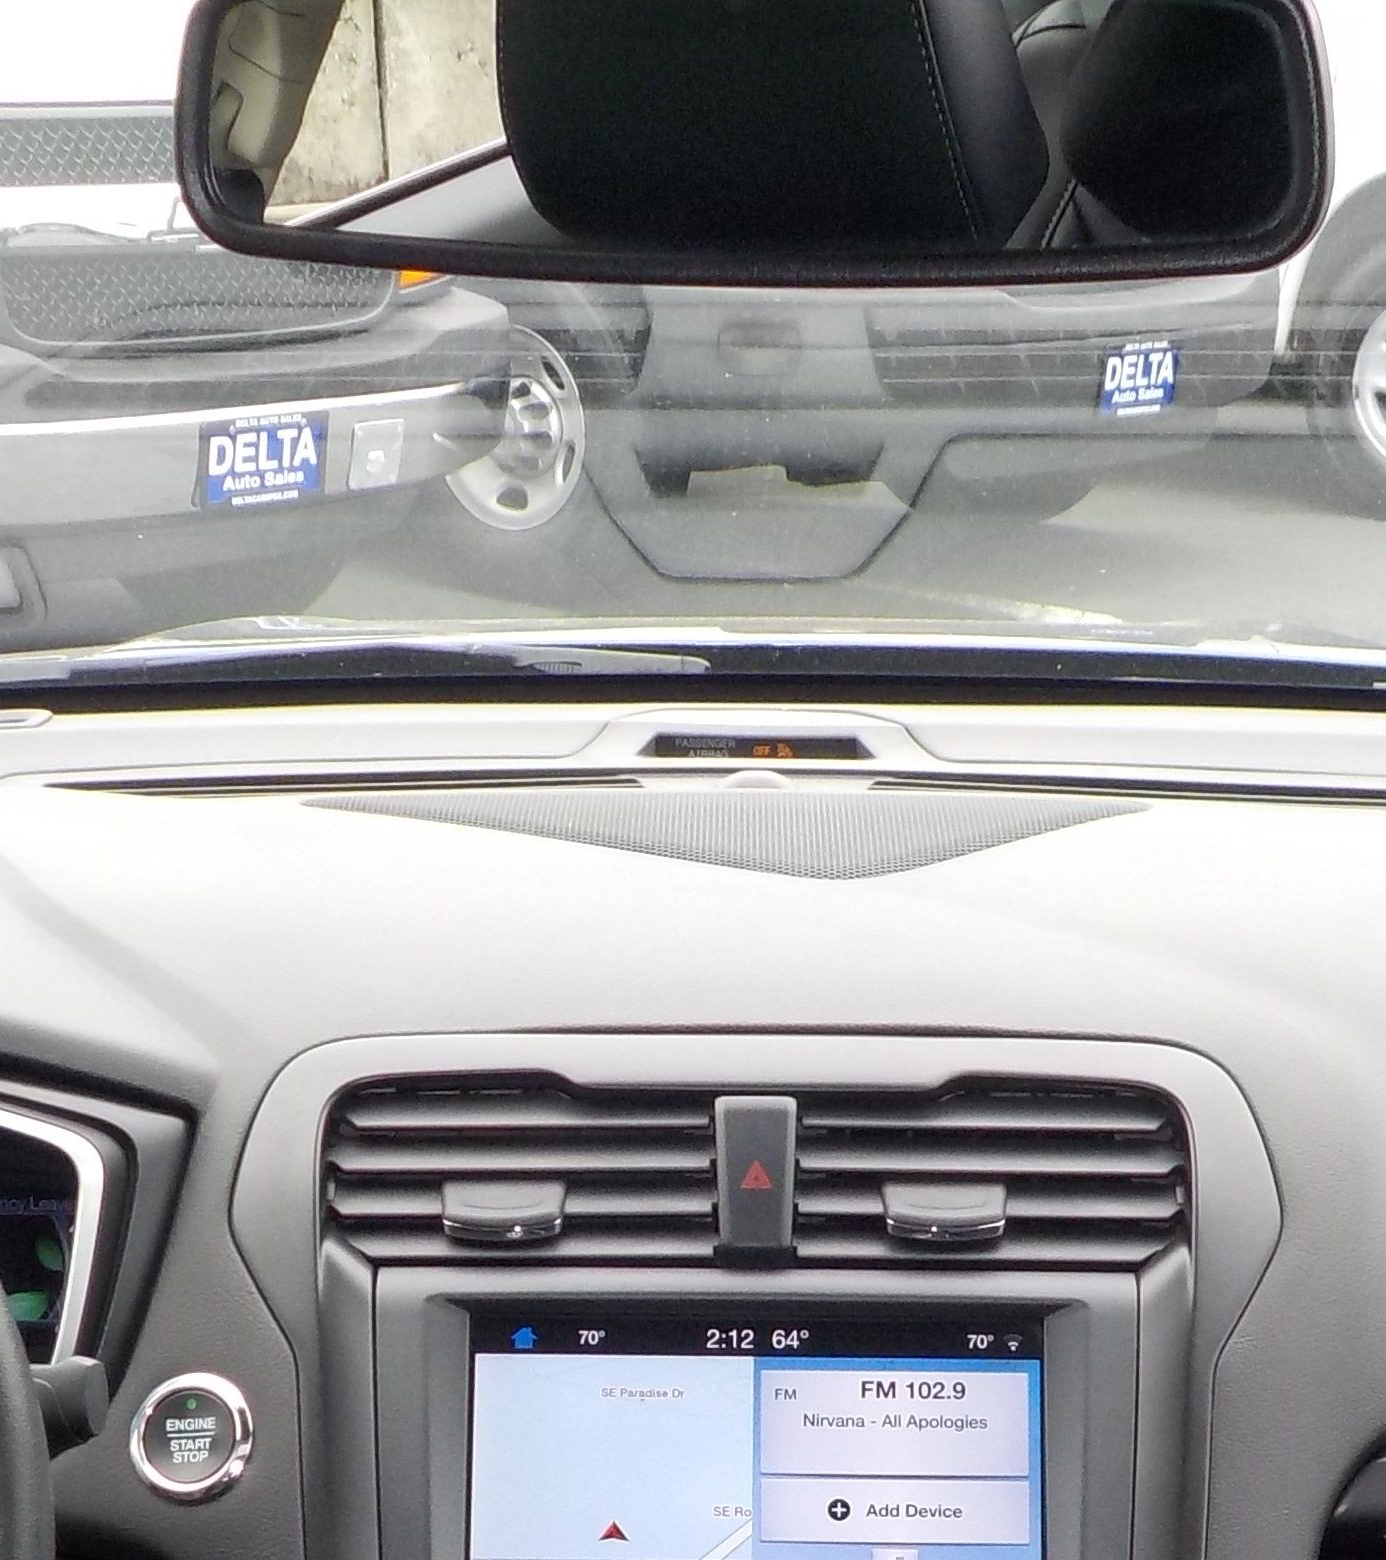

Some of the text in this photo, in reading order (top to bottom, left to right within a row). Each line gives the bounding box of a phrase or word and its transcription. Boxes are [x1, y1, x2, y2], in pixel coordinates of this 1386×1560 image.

[1104, 351, 1174, 391] DELTA
[1112, 389, 1137, 404] Auto
[208, 426, 318, 476] DELTA
[222, 470, 305, 492] Auto Sales
[675, 738, 736, 749] PASSENGER
[753, 745, 772, 757] OFF
[578, 1330, 606, 1346] 70°
[706, 1329, 810, 1350] 2:12 64°
[966, 1334, 994, 1350] 70°
[601, 1387, 685, 1399] SE Paradise Dr
[774, 1388, 798, 1401] FM
[860, 1380, 966, 1400] FM 102.9
[166, 1416, 216, 1431] ENGINE
[803, 1413, 866, 1428] Nirvana
[881, 1414, 902, 1429] All
[906, 1414, 988, 1432] Apologies
[170, 1438, 213, 1451] START
[173, 1450, 209, 1464] STOP
[713, 1506, 731, 1517] SE
[866, 1503, 963, 1518] Add Device
